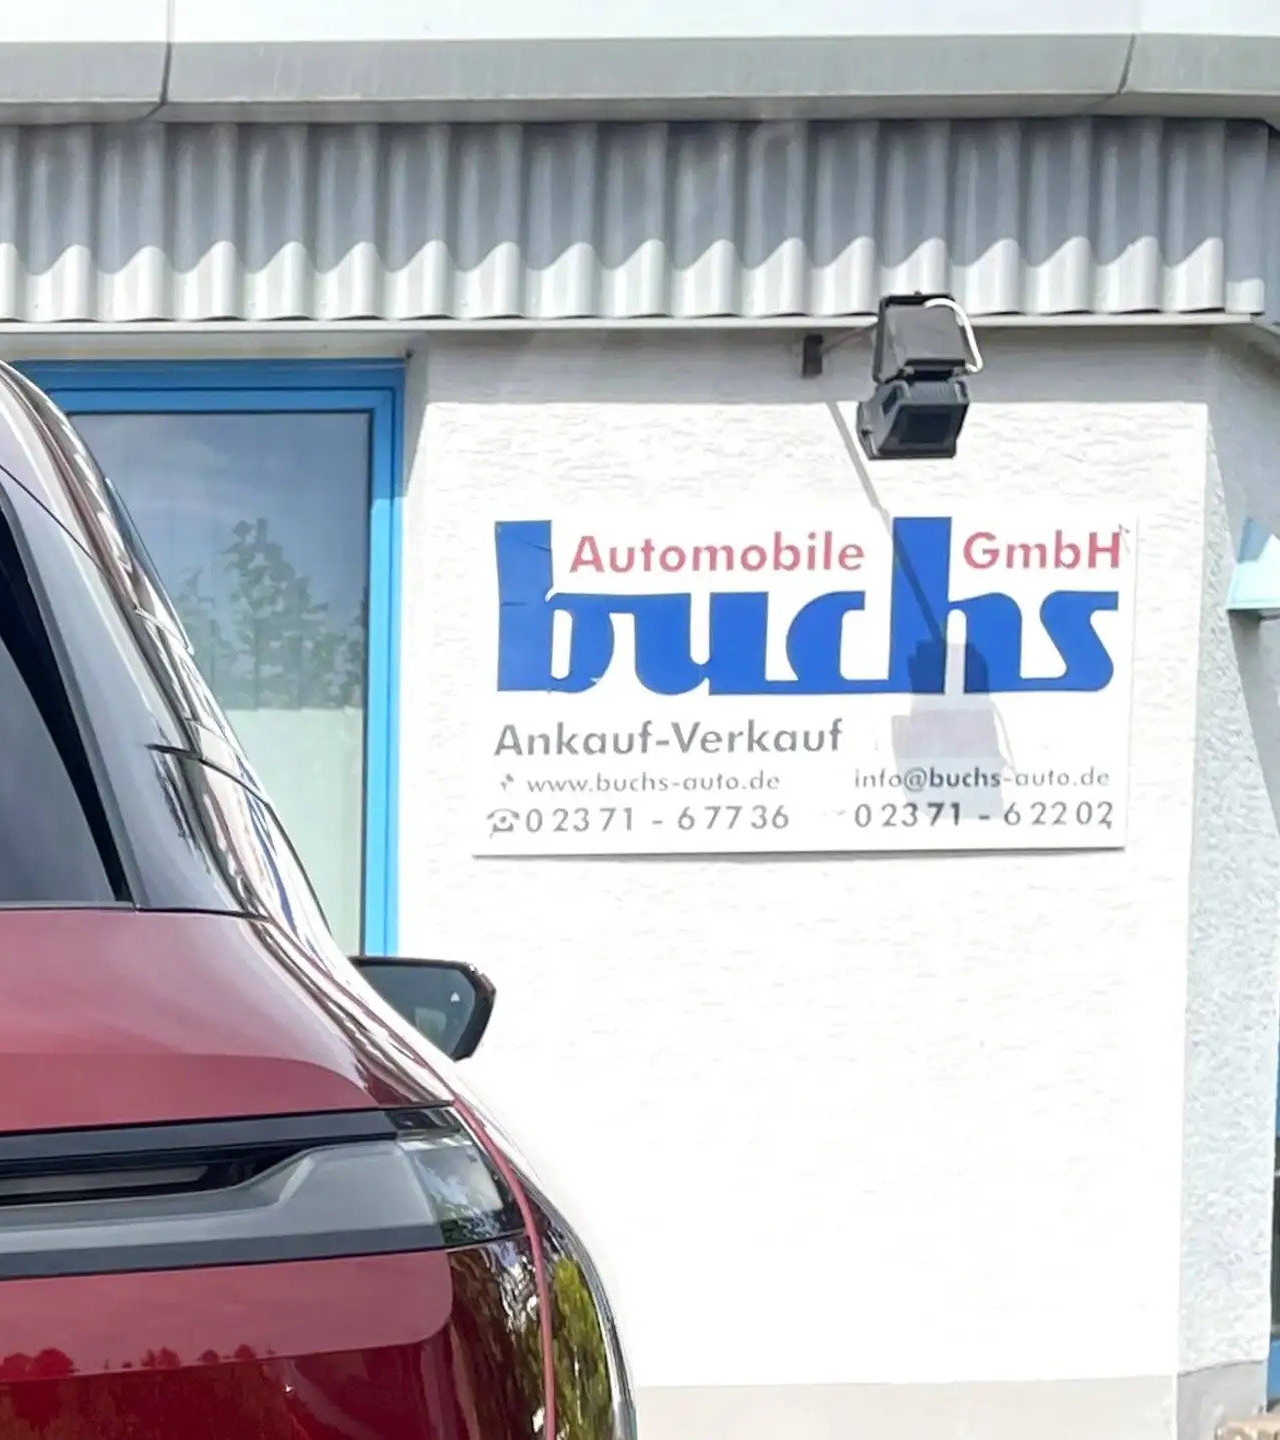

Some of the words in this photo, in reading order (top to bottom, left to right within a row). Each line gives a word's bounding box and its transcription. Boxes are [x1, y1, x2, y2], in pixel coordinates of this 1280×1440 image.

[569, 531, 865, 574] Automobile
[963, 529, 1121, 571] GmbH
[494, 516, 1120, 696] buchs
[493, 718, 843, 756] Ankauf-Verkauf
[527, 770, 780, 793] www.buchs-auto.de
[854, 766, 1110, 792] info@buchs-auto.de
[525, 806, 634, 833] 02371
[677, 804, 790, 831] 67736
[854, 802, 961, 828] 02371
[1003, 801, 1114, 828] 62202
